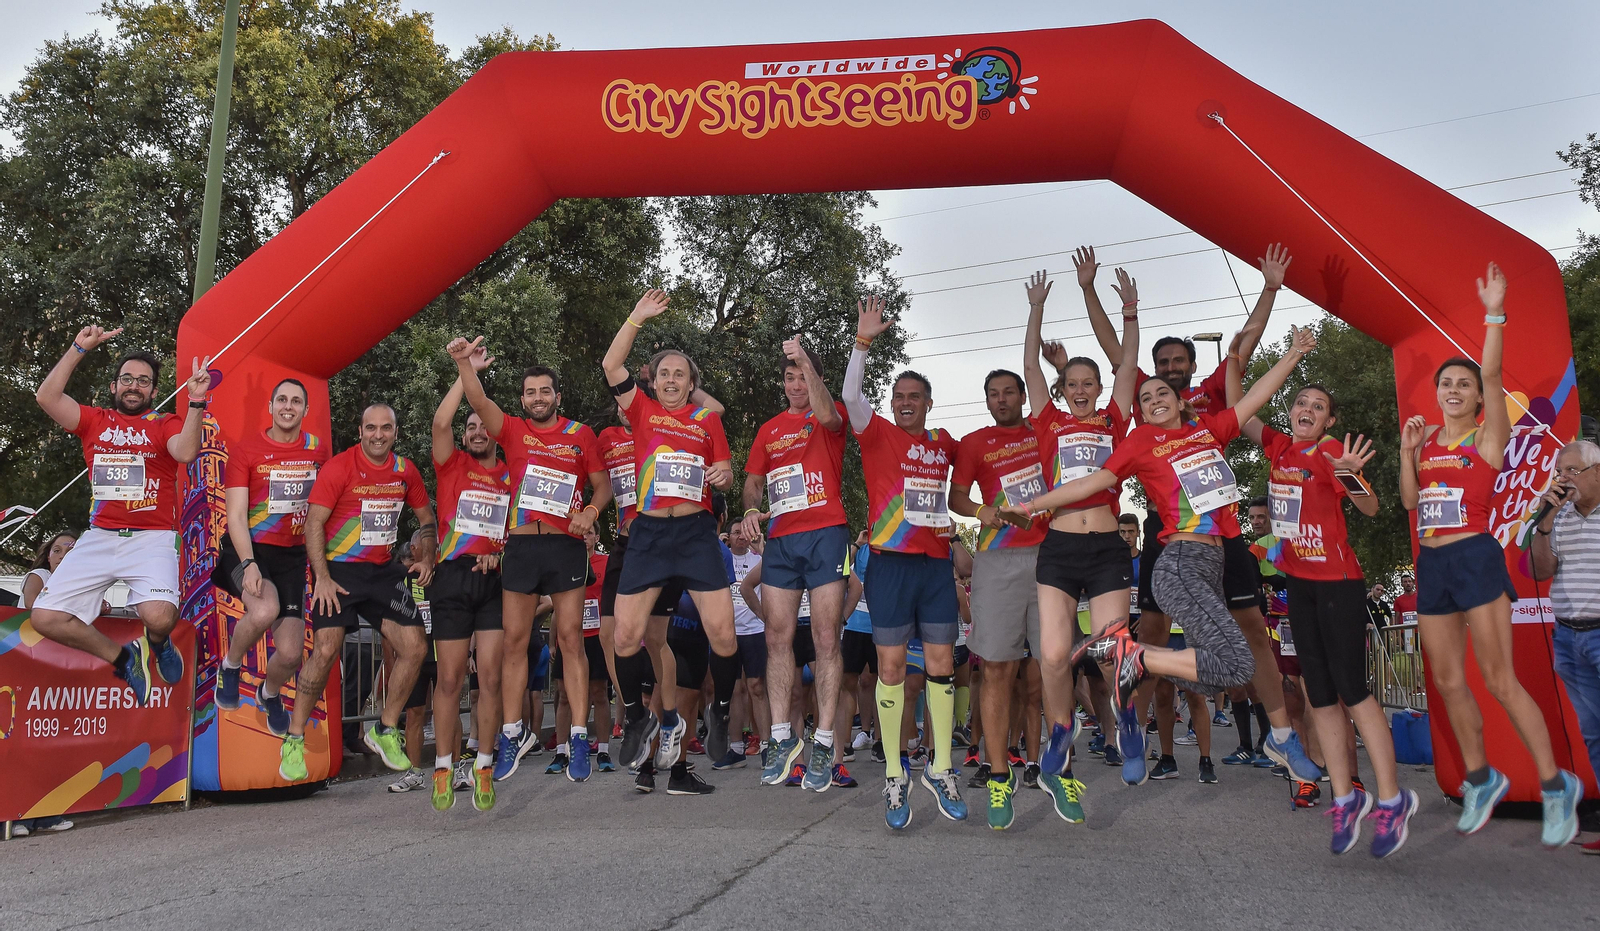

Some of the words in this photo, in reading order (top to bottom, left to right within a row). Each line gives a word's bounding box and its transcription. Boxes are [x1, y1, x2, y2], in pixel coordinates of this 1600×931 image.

[761, 57, 930, 76] Worldwide
[1075, 446, 1098, 461] 537
[106, 467, 129, 480] 538
[669, 464, 691, 479] 545
[900, 463, 918, 472] Reto
[918, 465, 940, 475] Zurich
[1197, 465, 1223, 486] 546
[536, 480, 560, 495] 547
[621, 475, 636, 489] 549
[1494, 468, 1536, 493] ow
[283, 483, 304, 495] 539
[1019, 479, 1042, 498] 548
[124, 497, 158, 510] Team
[808, 491, 828, 505] am
[917, 492, 936, 507] 541
[471, 502, 493, 518] 540
[1422, 503, 1443, 520] 544
[373, 514, 392, 527] 536
[25, 717, 59, 738] 1999
[73, 716, 107, 736] 2019
